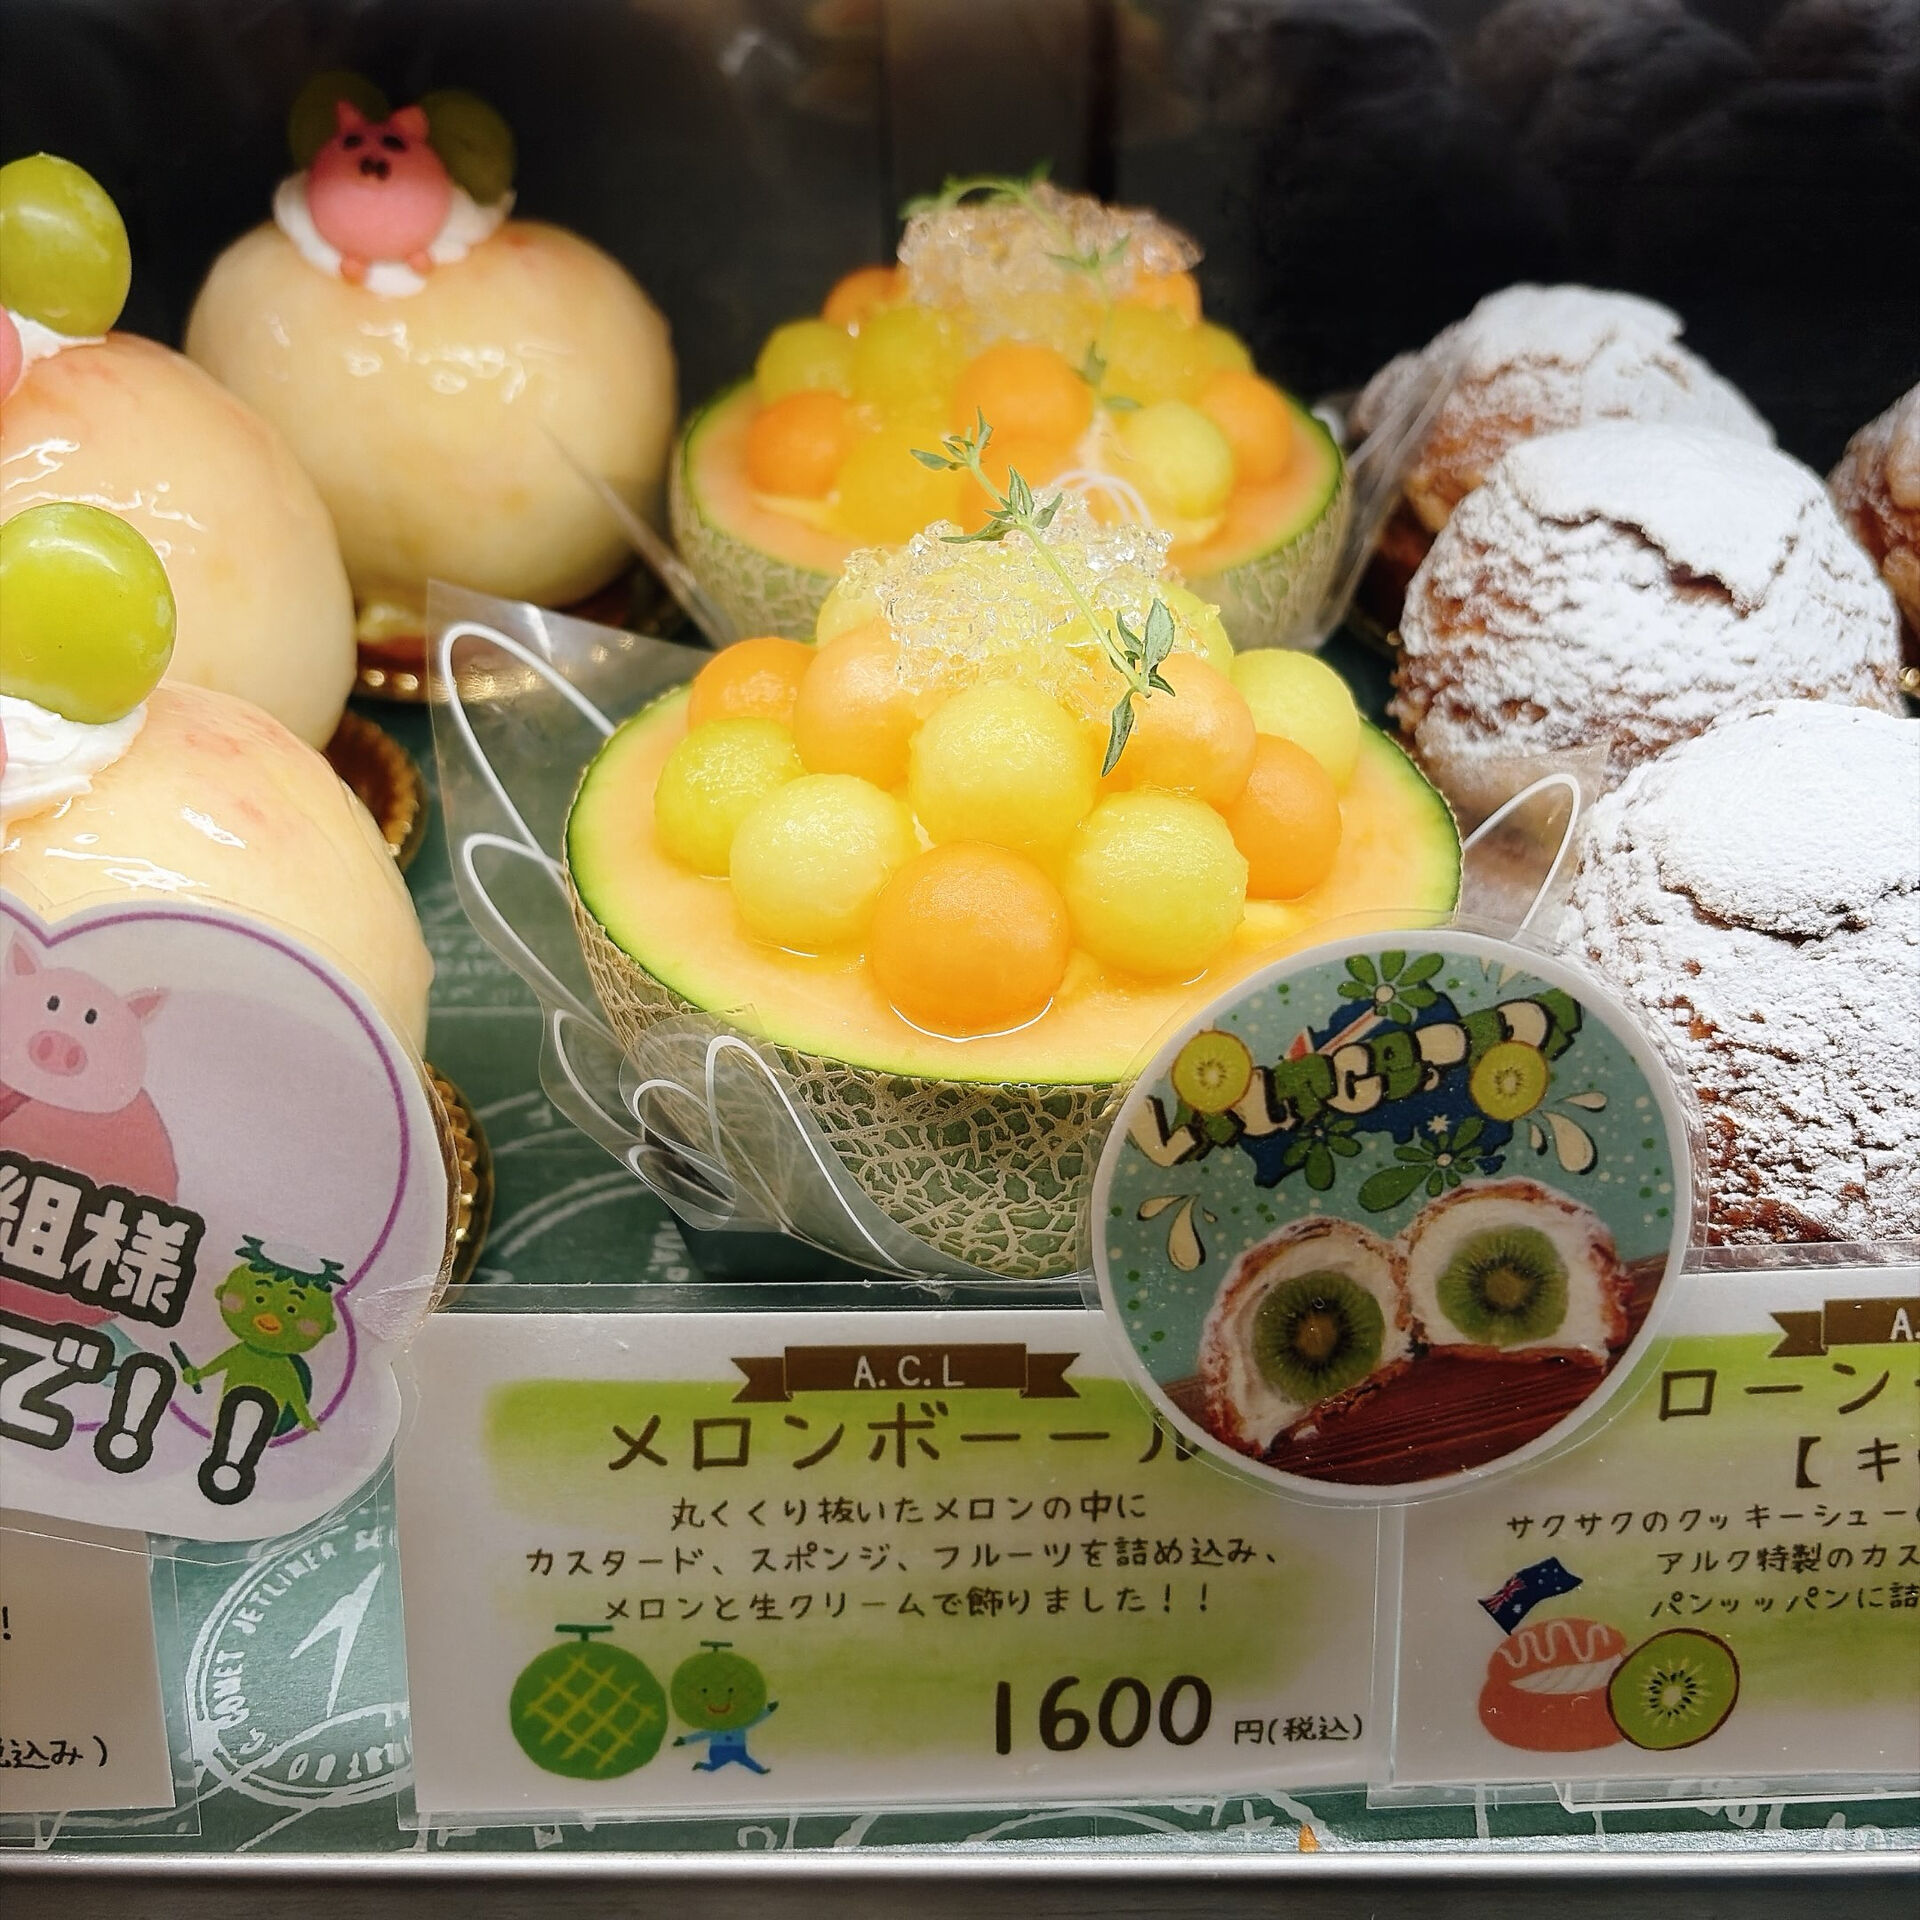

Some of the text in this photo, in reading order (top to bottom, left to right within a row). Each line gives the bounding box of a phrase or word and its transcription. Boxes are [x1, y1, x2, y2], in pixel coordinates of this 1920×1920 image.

[0, 1154, 203, 1324] 組様
[853, 1354, 965, 1388] A.C.L
[1659, 1363, 1920, 1421] ローン
[670, 1489, 1146, 1531] 丸くくり抜いたメロンの中に
[1506, 1503, 1920, 1539] サクサクのクッキーシュー
[1656, 1543, 1920, 1575] アルク特製のカス
[995, 1674, 1213, 1755] 1600
